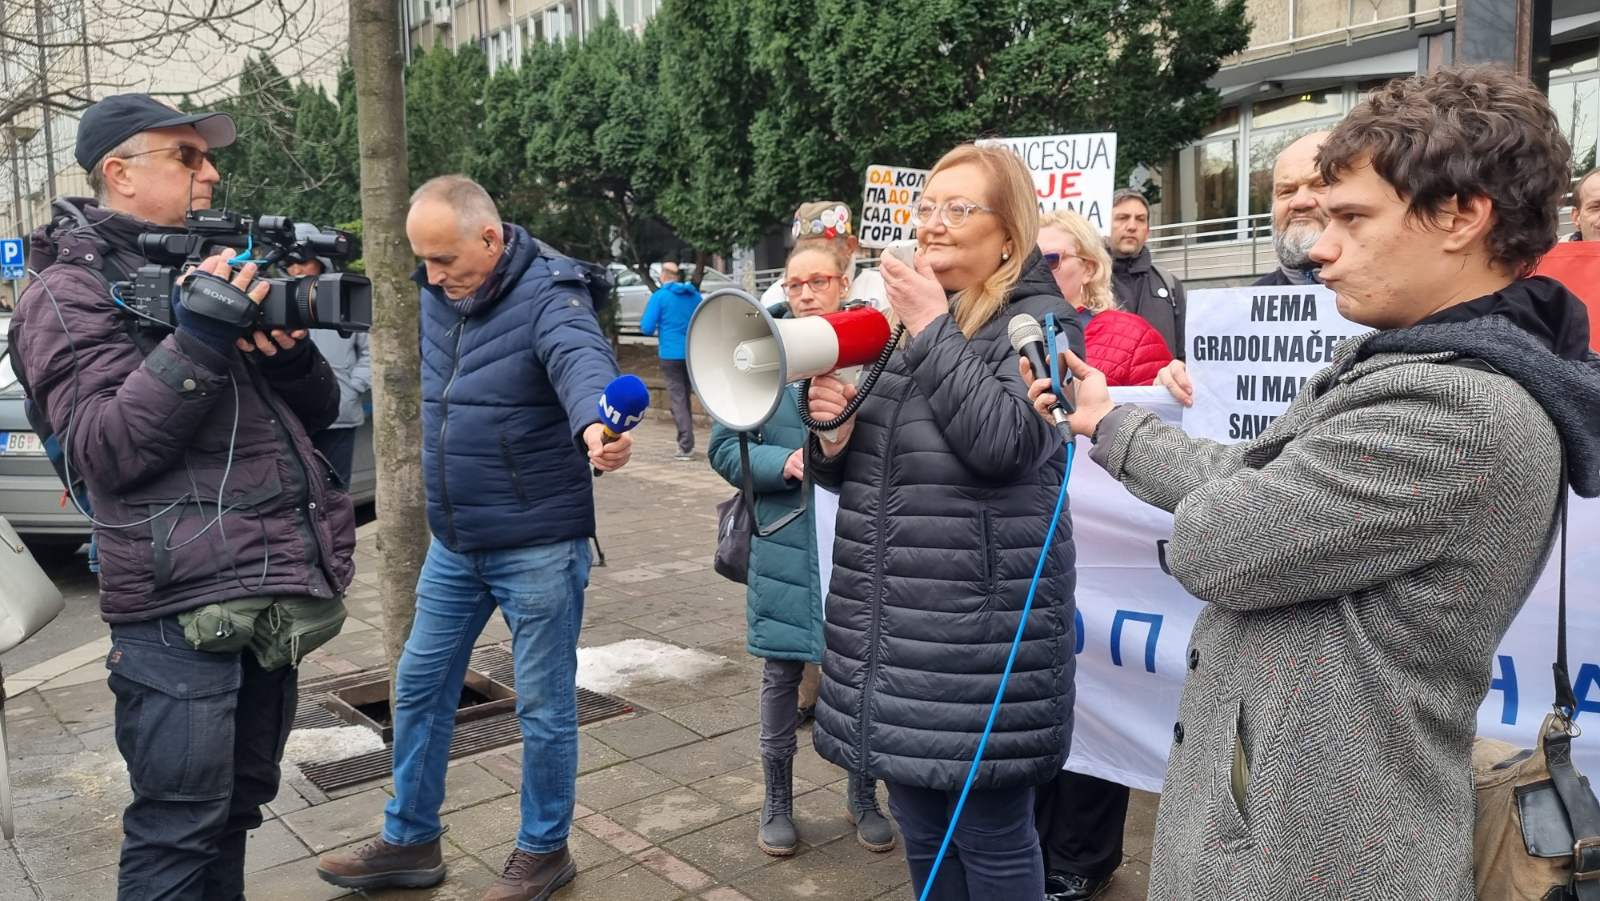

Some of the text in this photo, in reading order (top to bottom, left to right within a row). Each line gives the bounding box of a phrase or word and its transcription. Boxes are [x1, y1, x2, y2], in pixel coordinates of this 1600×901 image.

[870, 170, 893, 186] ОД
[1037, 172, 1082, 199] JE
[867, 188, 886, 204] ПА
[888, 189, 909, 205] ДО
[864, 207, 891, 224] САД
[861, 226, 902, 241] ГОРА
[5, 242, 18, 263] P
[203, 288, 234, 305] SONY
[1251, 294, 1317, 322] NEMA
[1194, 330, 1357, 363] GRADOLNAČE
[1237, 375, 1256, 401] NI
[1229, 413, 1279, 440] SAV
[9, 435, 26, 449] BG
